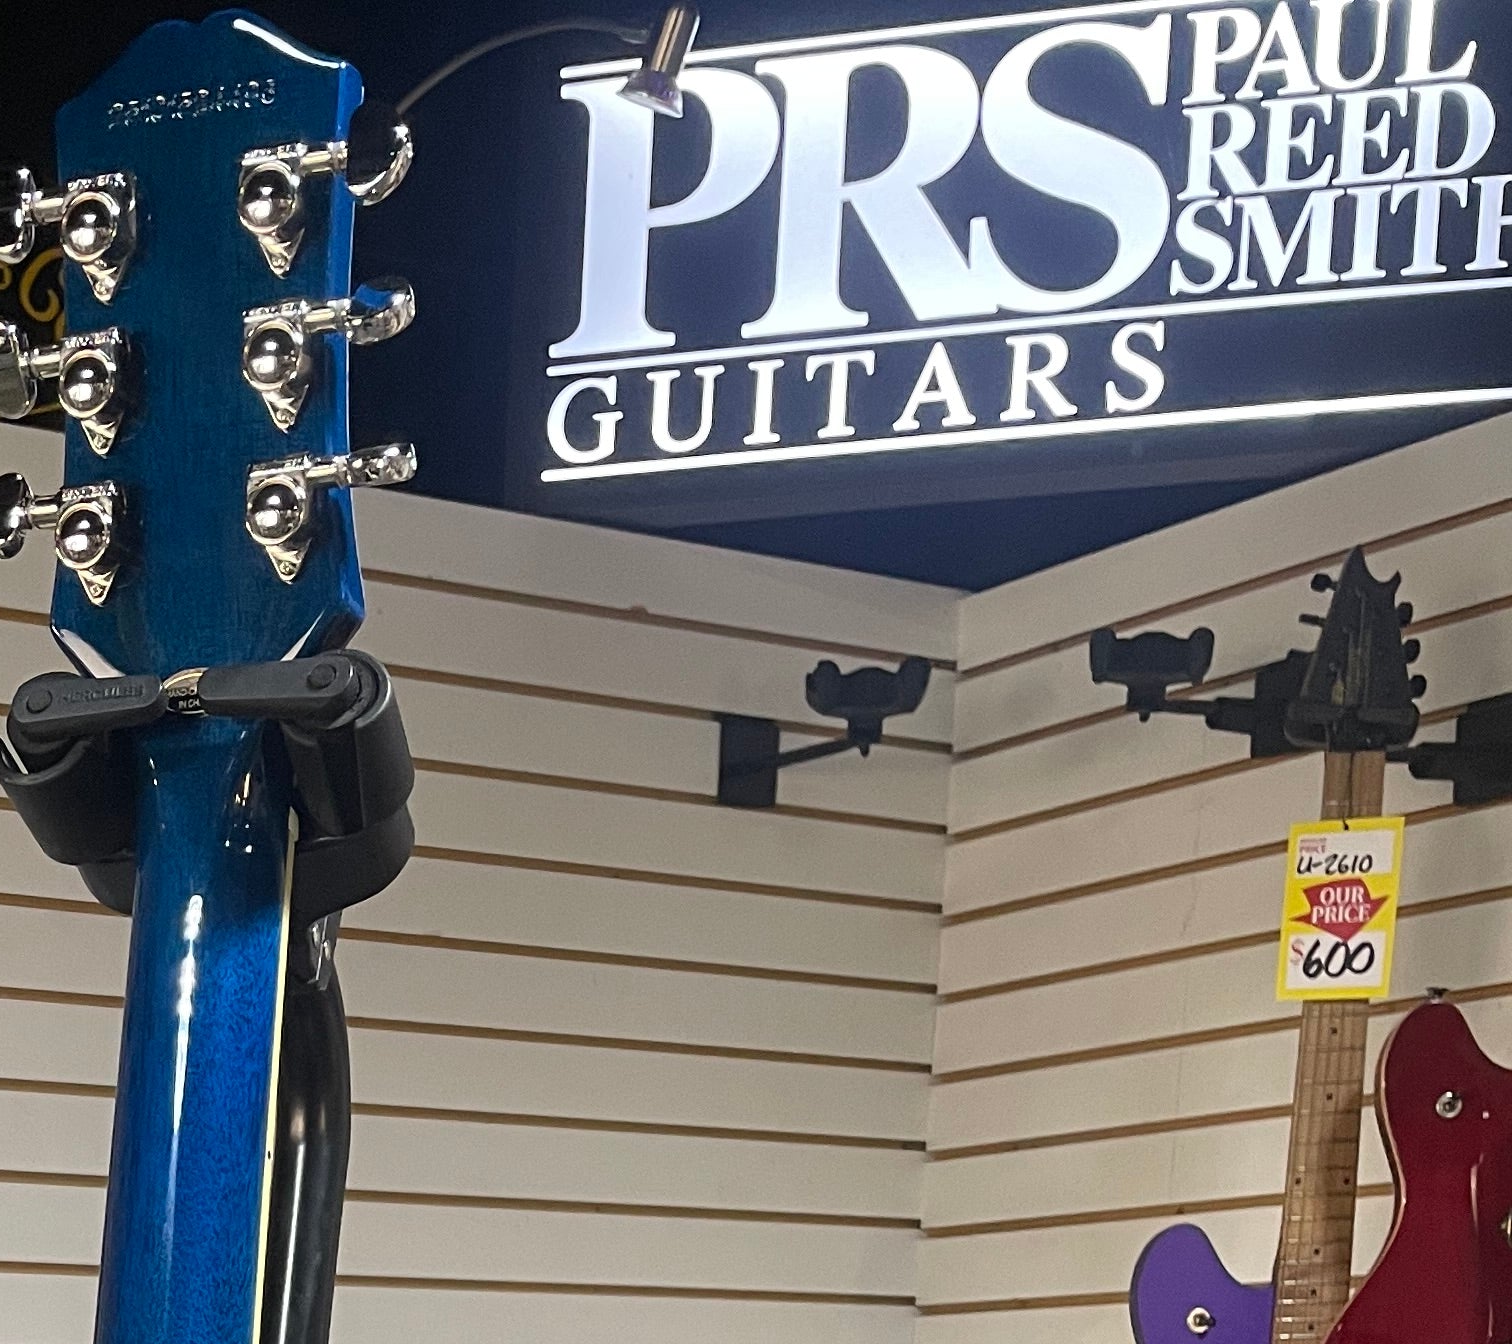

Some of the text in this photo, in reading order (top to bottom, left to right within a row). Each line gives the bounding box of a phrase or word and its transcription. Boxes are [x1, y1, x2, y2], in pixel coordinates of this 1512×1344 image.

[1181, 0, 1480, 107] PAUL
[549, 14, 1172, 358] PRS
[1176, 81, 1496, 201] REED
[545, 322, 1168, 465] GUITARS
[1311, 903, 1371, 925] PRICE
[1319, 886, 1365, 906] OUR
